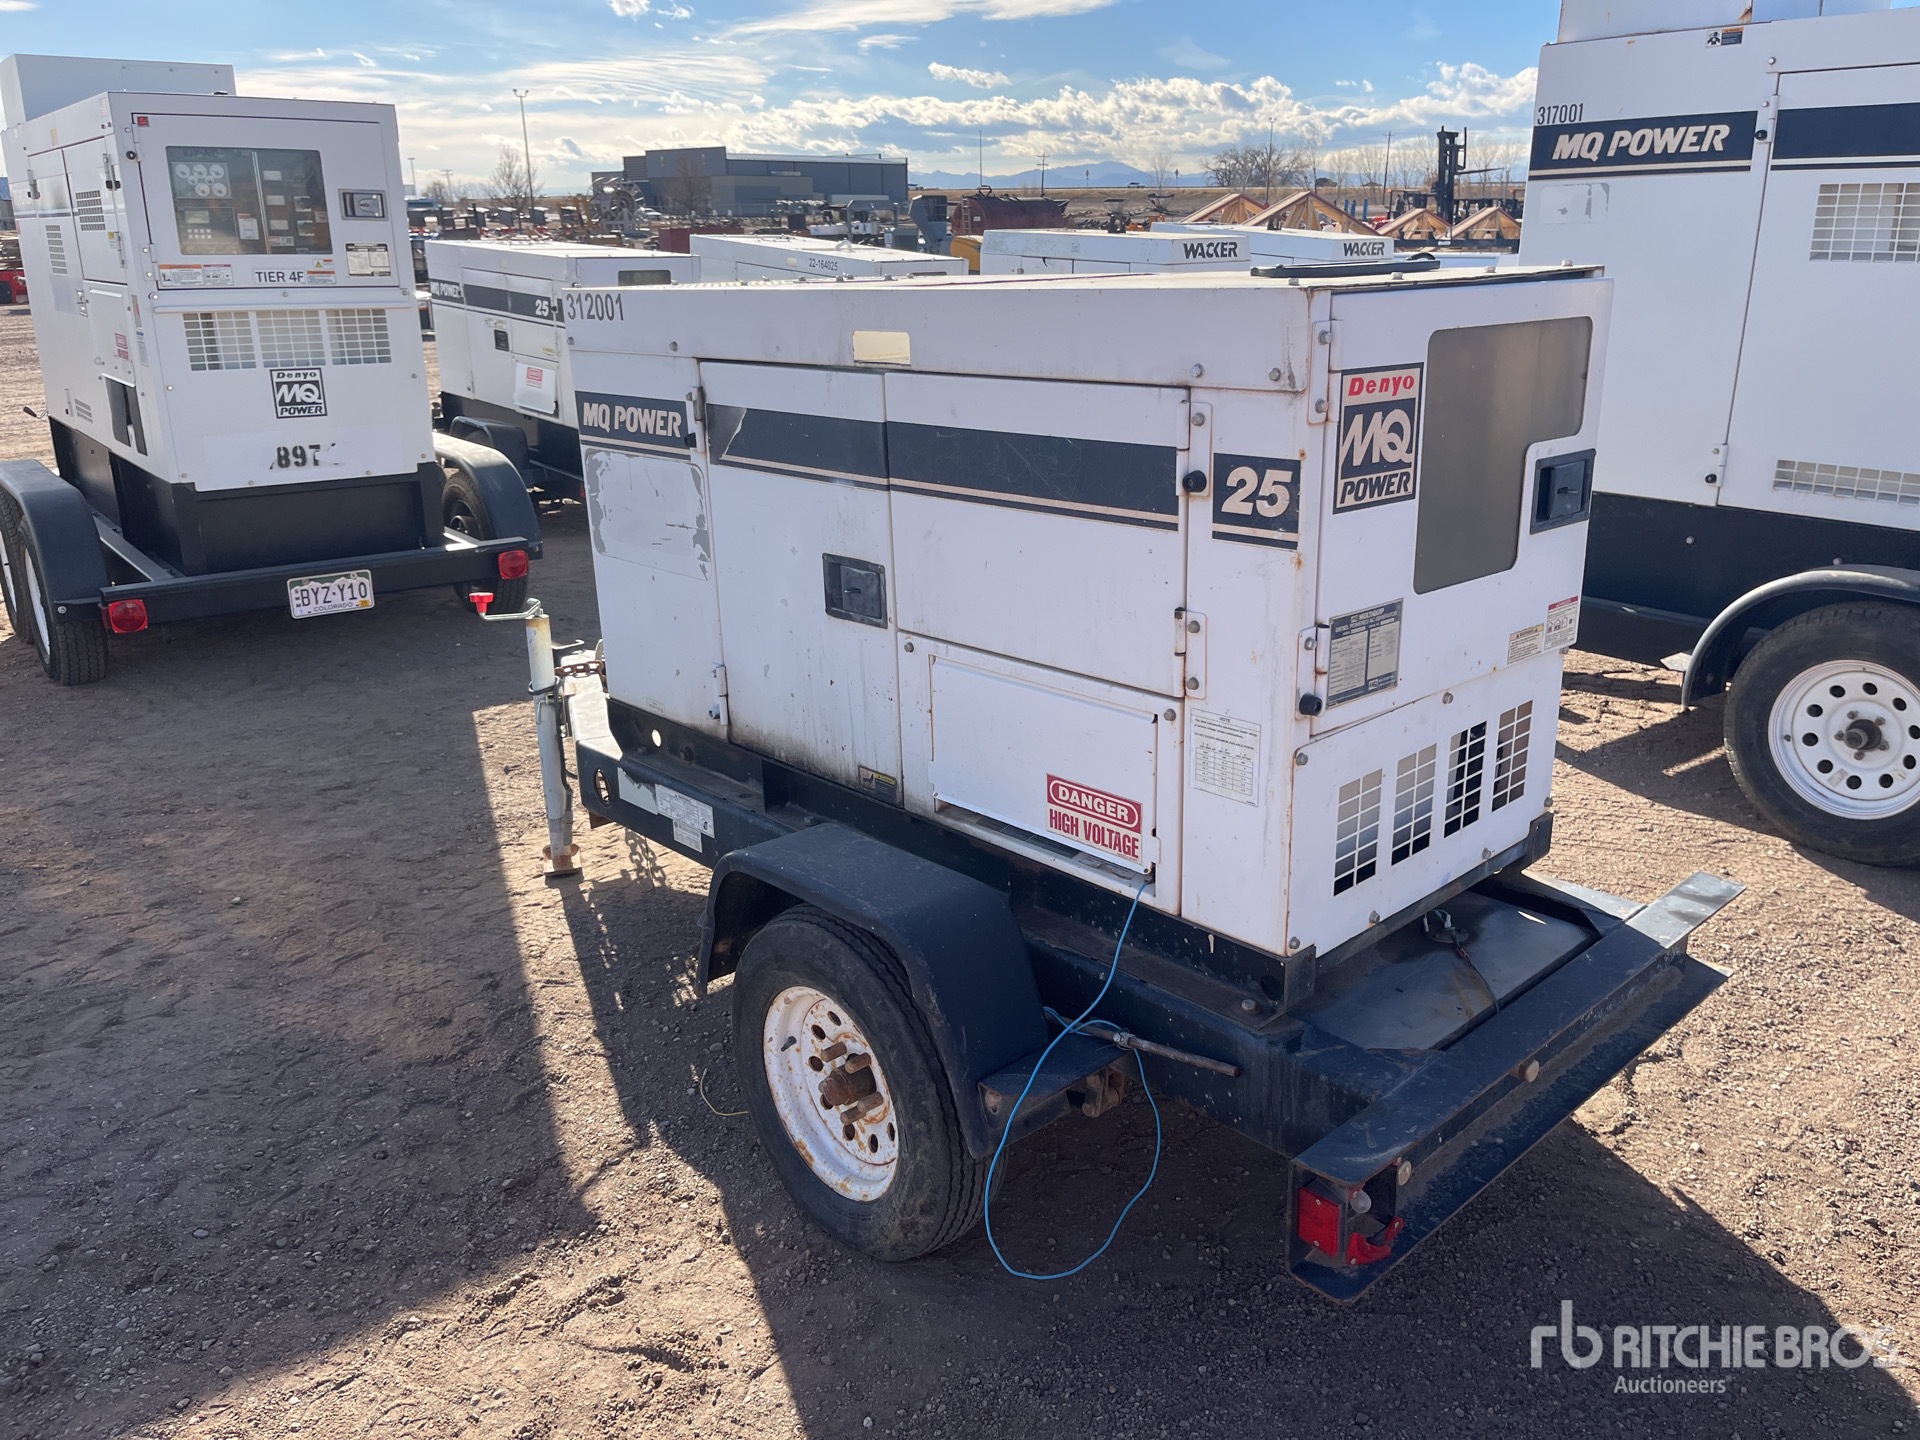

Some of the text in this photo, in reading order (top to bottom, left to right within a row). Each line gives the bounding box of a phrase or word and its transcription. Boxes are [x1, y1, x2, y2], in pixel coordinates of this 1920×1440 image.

[1537, 103, 1584, 125] 317001
[1552, 124, 1730, 162] MQ POWER
[1183, 241, 1238, 259] WACKER
[1343, 241, 1385, 256] WACKER
[255, 271, 286, 283] TIER
[289, 271, 304, 283] 4F
[535, 299, 549, 316] 25
[566, 293, 624, 321] 312001
[276, 383, 323, 404] MQ
[1348, 375, 1415, 397] Denyo
[280, 406, 323, 415] POWER
[583, 402, 681, 438] MQ POWER
[1342, 408, 1415, 467] MQ
[1221, 466, 1293, 518] 25
[1340, 471, 1411, 504] POWER
[313, 601, 354, 612] COLORADO
[1058, 785, 1129, 822] DANGER
[1049, 808, 1139, 859] HIGH VOLTAGE
